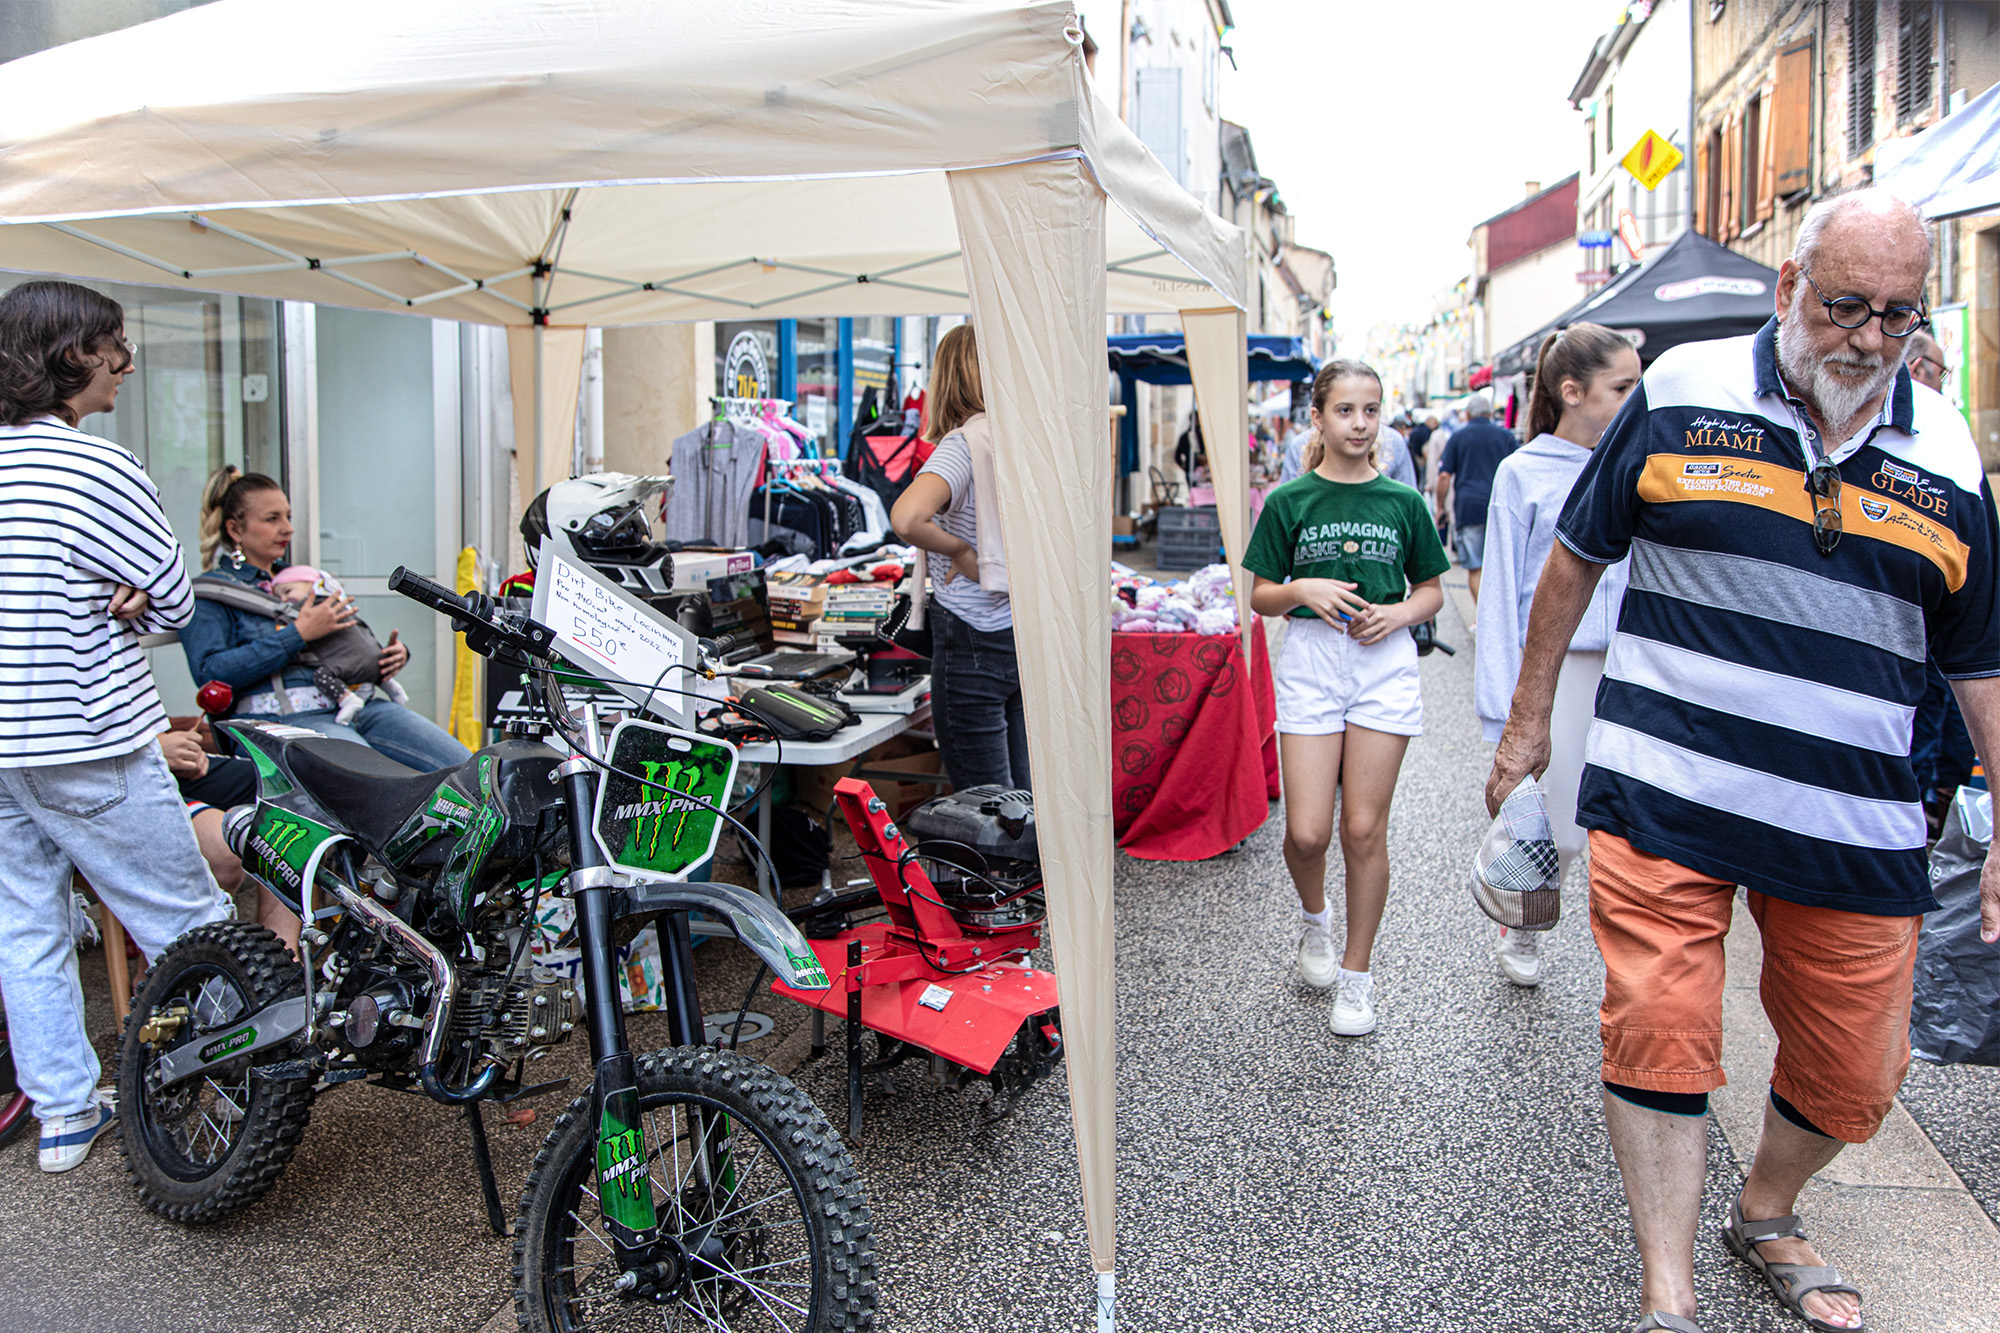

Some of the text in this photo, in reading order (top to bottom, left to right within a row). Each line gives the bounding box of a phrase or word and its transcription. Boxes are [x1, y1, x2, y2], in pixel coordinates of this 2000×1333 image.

[1690, 415, 1720, 430] High
[1685, 428, 1764, 453] MIAMI
[1719, 465, 1763, 480] Sector
[1676, 476, 1775, 495] EXPLORING THE FOREST
[1716, 484, 1765, 498] SQUADRON
[1871, 471, 1948, 517] GLADE
[1916, 478, 1946, 495] Ever
[1299, 526, 1319, 543] AS
[1361, 540, 1398, 561] CLUB
[556, 590, 569, 602] Non
[558, 562, 586, 589] Dirt
[595, 587, 624, 613] Bike
[557, 579, 570, 592] Pro
[639, 633, 665, 654] 2022
[432, 796, 474, 824] MMX PRO
[614, 800, 667, 821] MMX
[249, 834, 302, 888] MMX PRO
[796, 967, 816, 979] MMX
[205, 1031, 250, 1058] MMX PRO
[602, 1152, 640, 1184] MMX
[630, 1160, 649, 1184] PR
